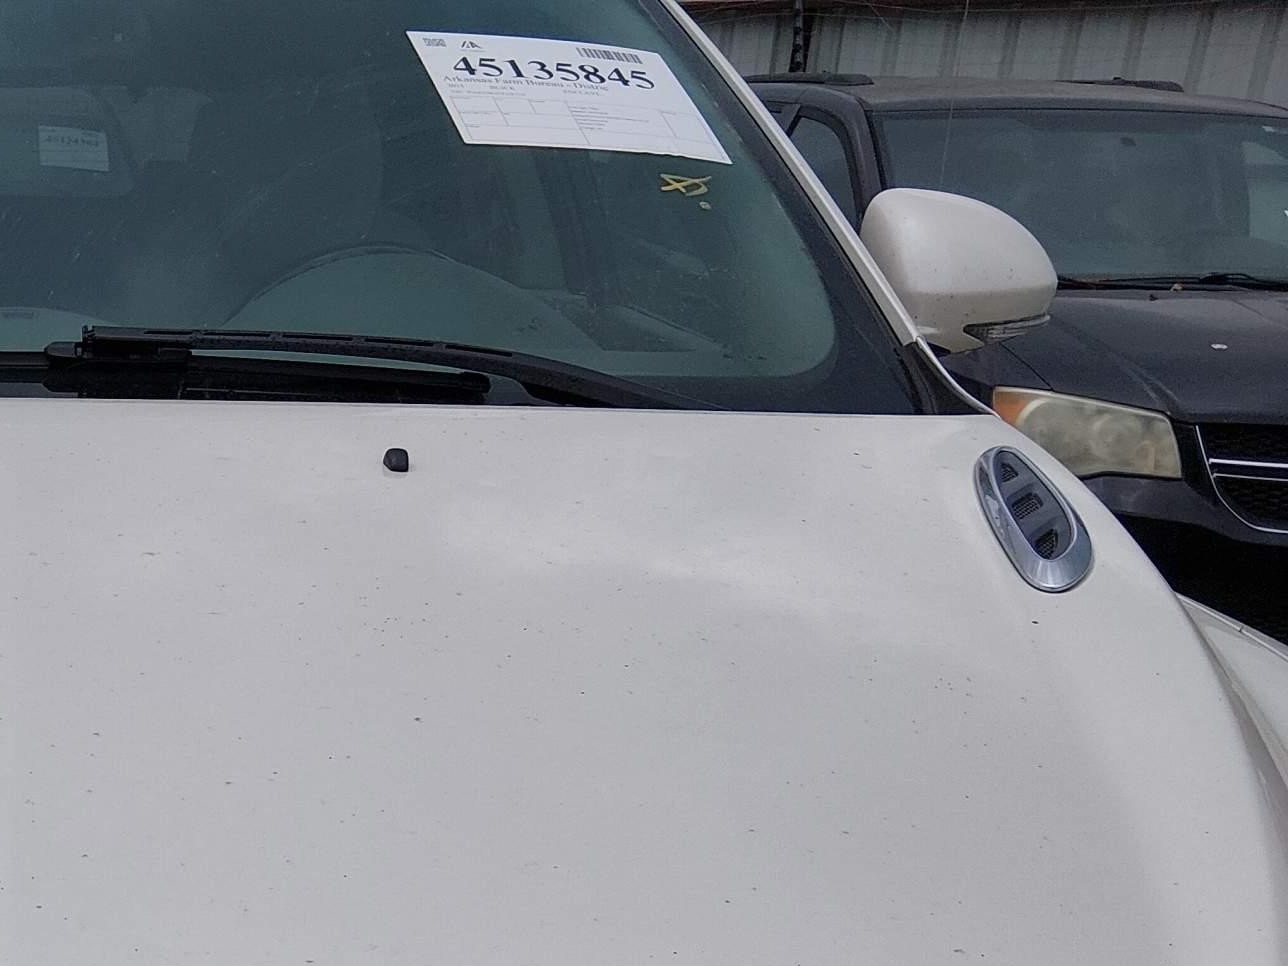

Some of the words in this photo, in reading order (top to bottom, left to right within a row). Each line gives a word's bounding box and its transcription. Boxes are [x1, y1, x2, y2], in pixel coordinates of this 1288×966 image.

[443, 75, 493, 84] Arkansas
[495, 77, 524, 85] Farm
[526, 80, 565, 88] Bureau
[453, 56, 655, 90] 45135845
